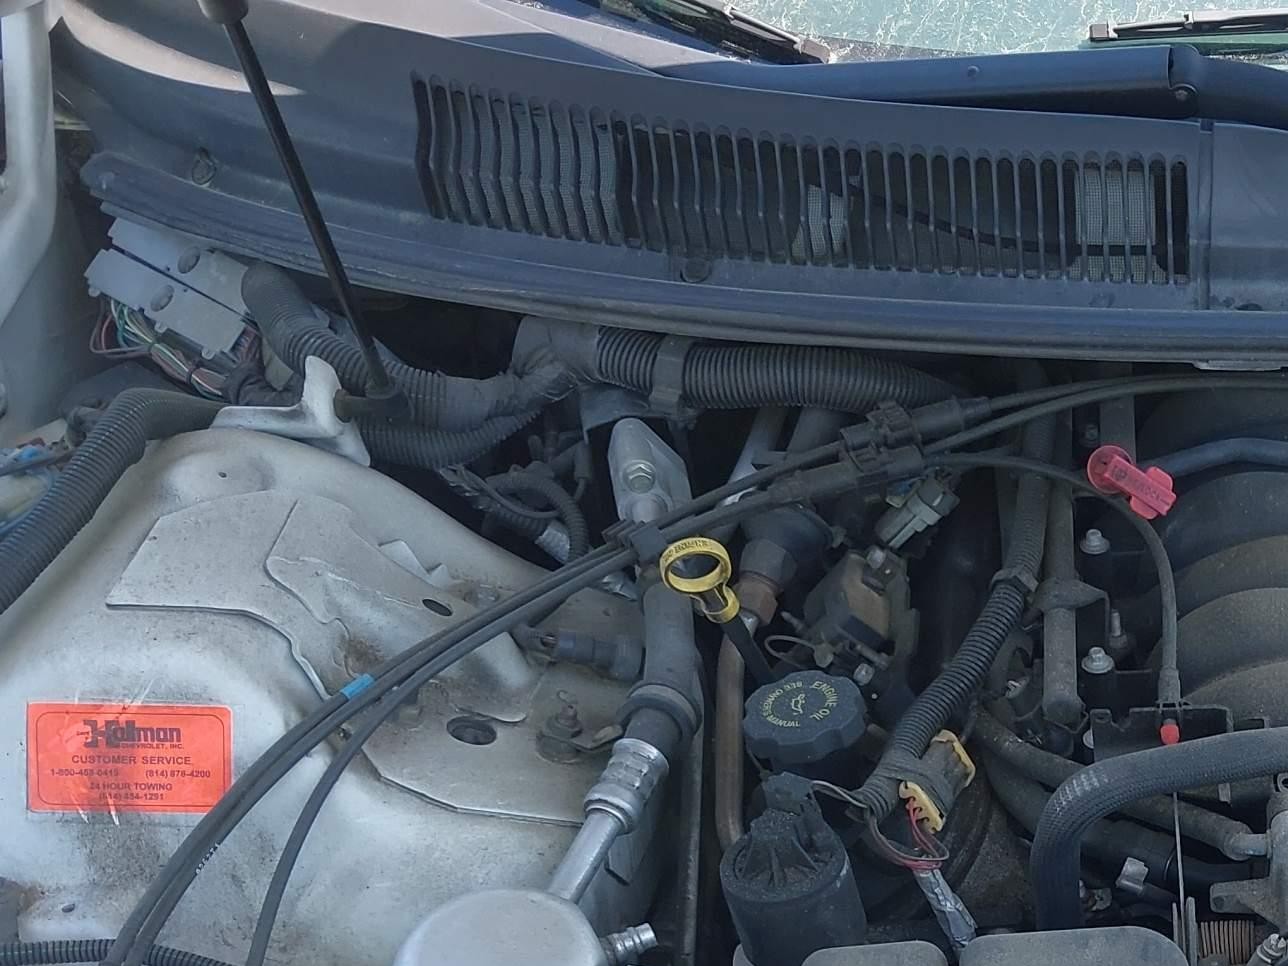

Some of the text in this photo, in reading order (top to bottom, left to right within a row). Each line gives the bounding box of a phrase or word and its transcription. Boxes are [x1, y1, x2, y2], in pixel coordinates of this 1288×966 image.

[810, 680, 838, 720] ENGINE OIL
[72, 755, 192, 766] CUSTOMER SERVICE
[102, 782, 131, 790] HOUR
[134, 782, 172, 791] TOWING
